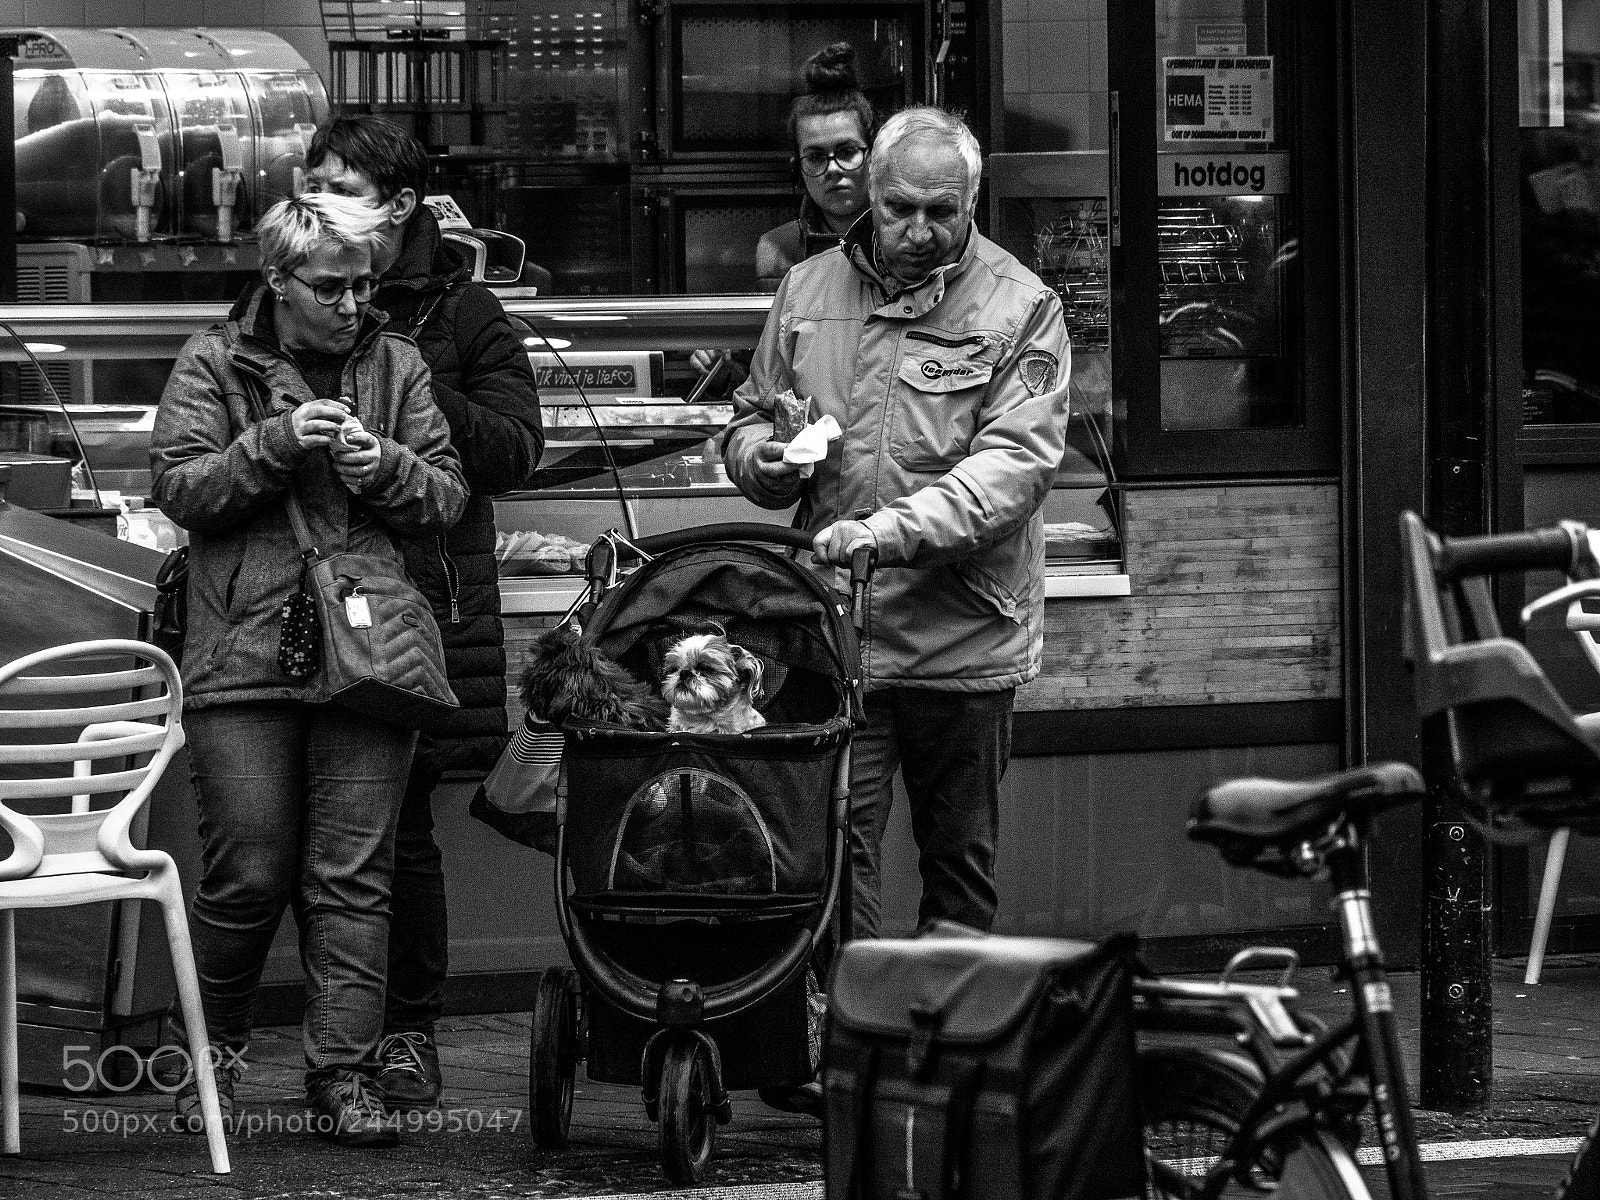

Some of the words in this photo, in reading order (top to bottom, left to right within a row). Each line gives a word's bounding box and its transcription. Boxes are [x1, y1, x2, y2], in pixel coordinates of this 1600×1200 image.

[1168, 94, 1203, 107] HEMA
[1174, 161, 1265, 192] hotdog
[581, 369, 594, 389] je
